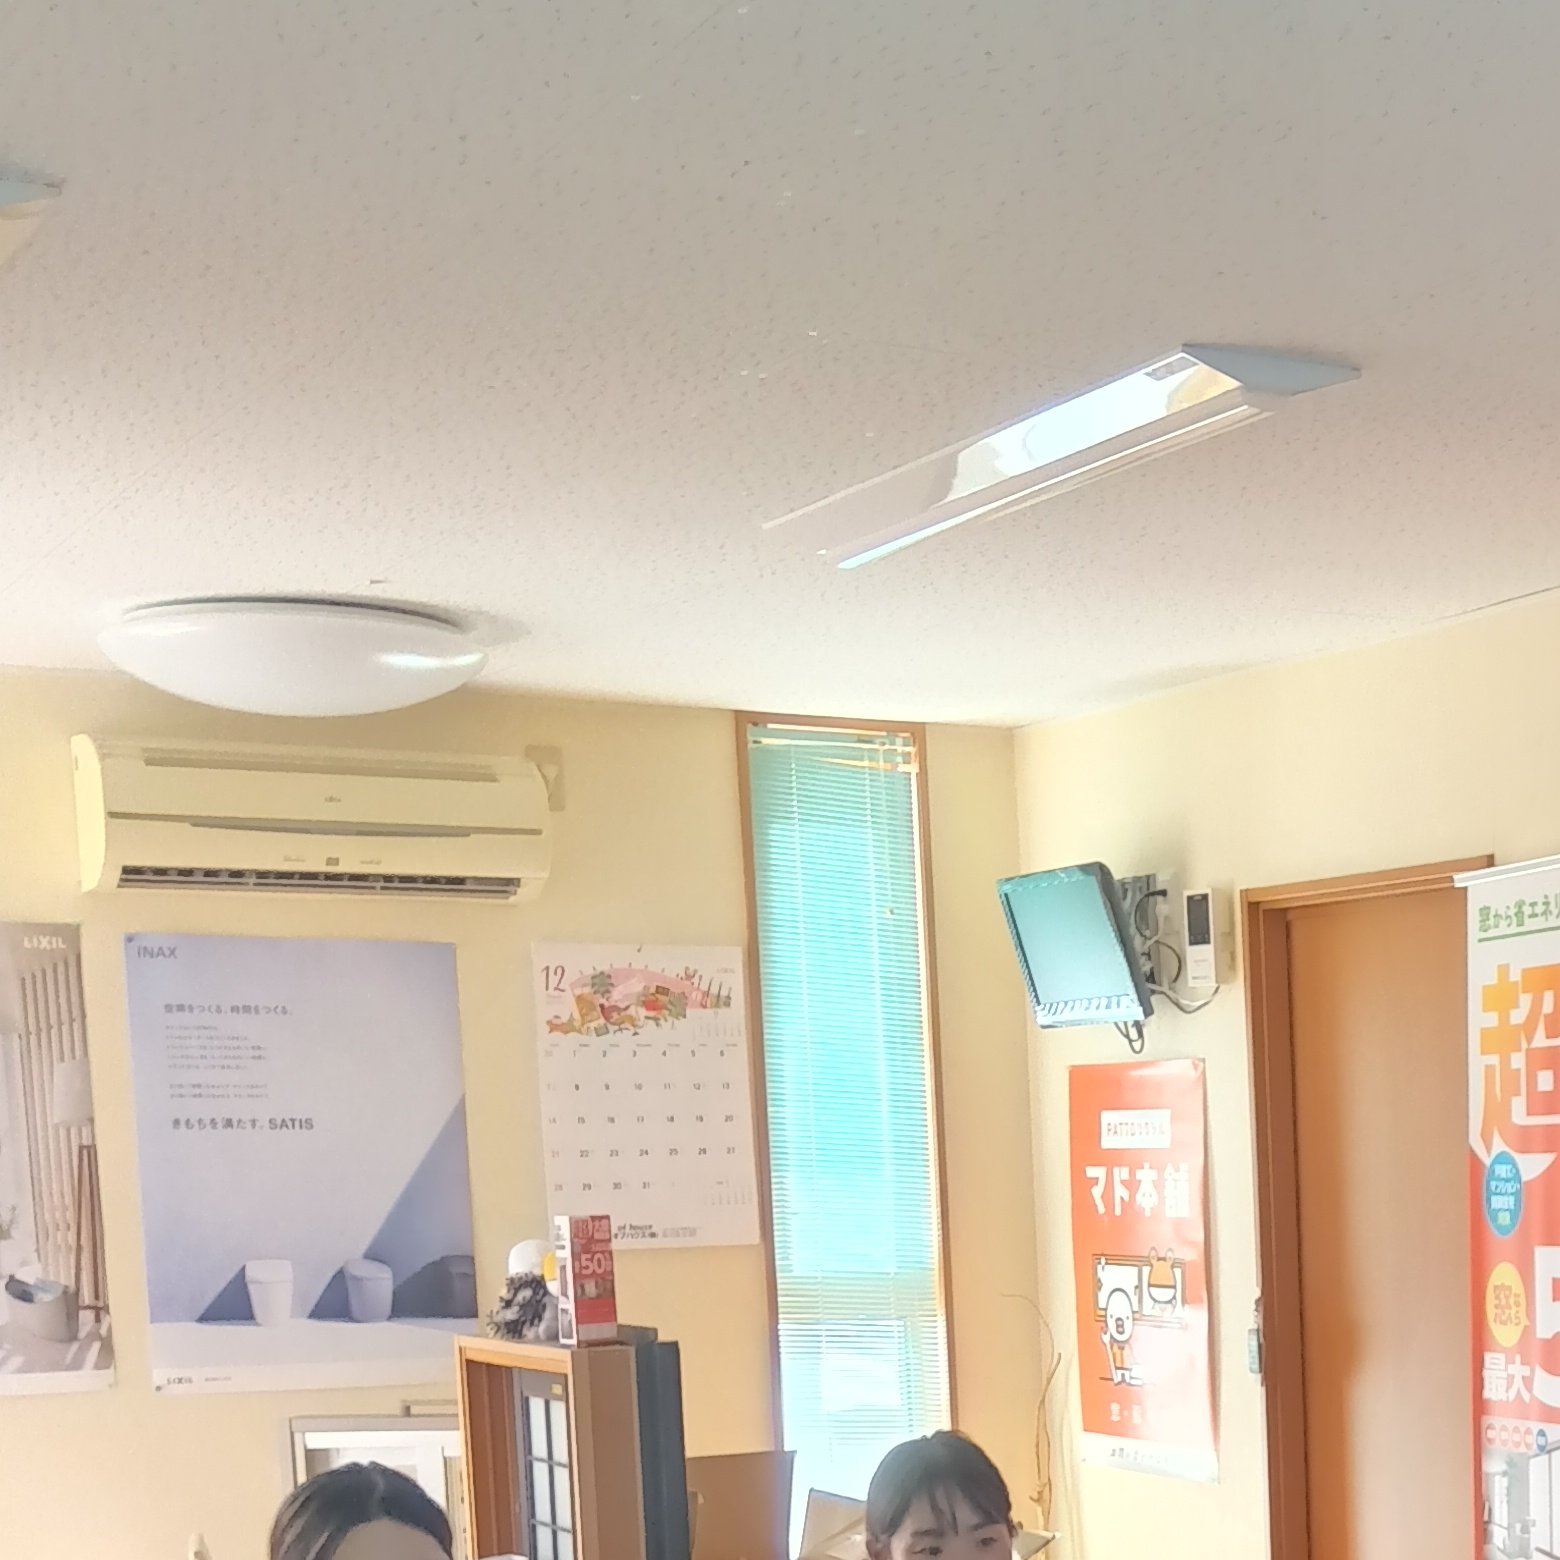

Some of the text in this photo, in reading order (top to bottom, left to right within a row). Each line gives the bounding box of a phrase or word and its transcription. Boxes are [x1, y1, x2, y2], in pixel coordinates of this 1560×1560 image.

[24, 935, 67, 950] LIXIL
[137, 946, 178, 959] INAX
[541, 965, 566, 993] 12
[268, 1117, 314, 1131] SATIS
[1084, 1162, 1190, 1218] マド本舗
[581, 1253, 605, 1275] 50
[1482, 1351, 1531, 1403] 最大
